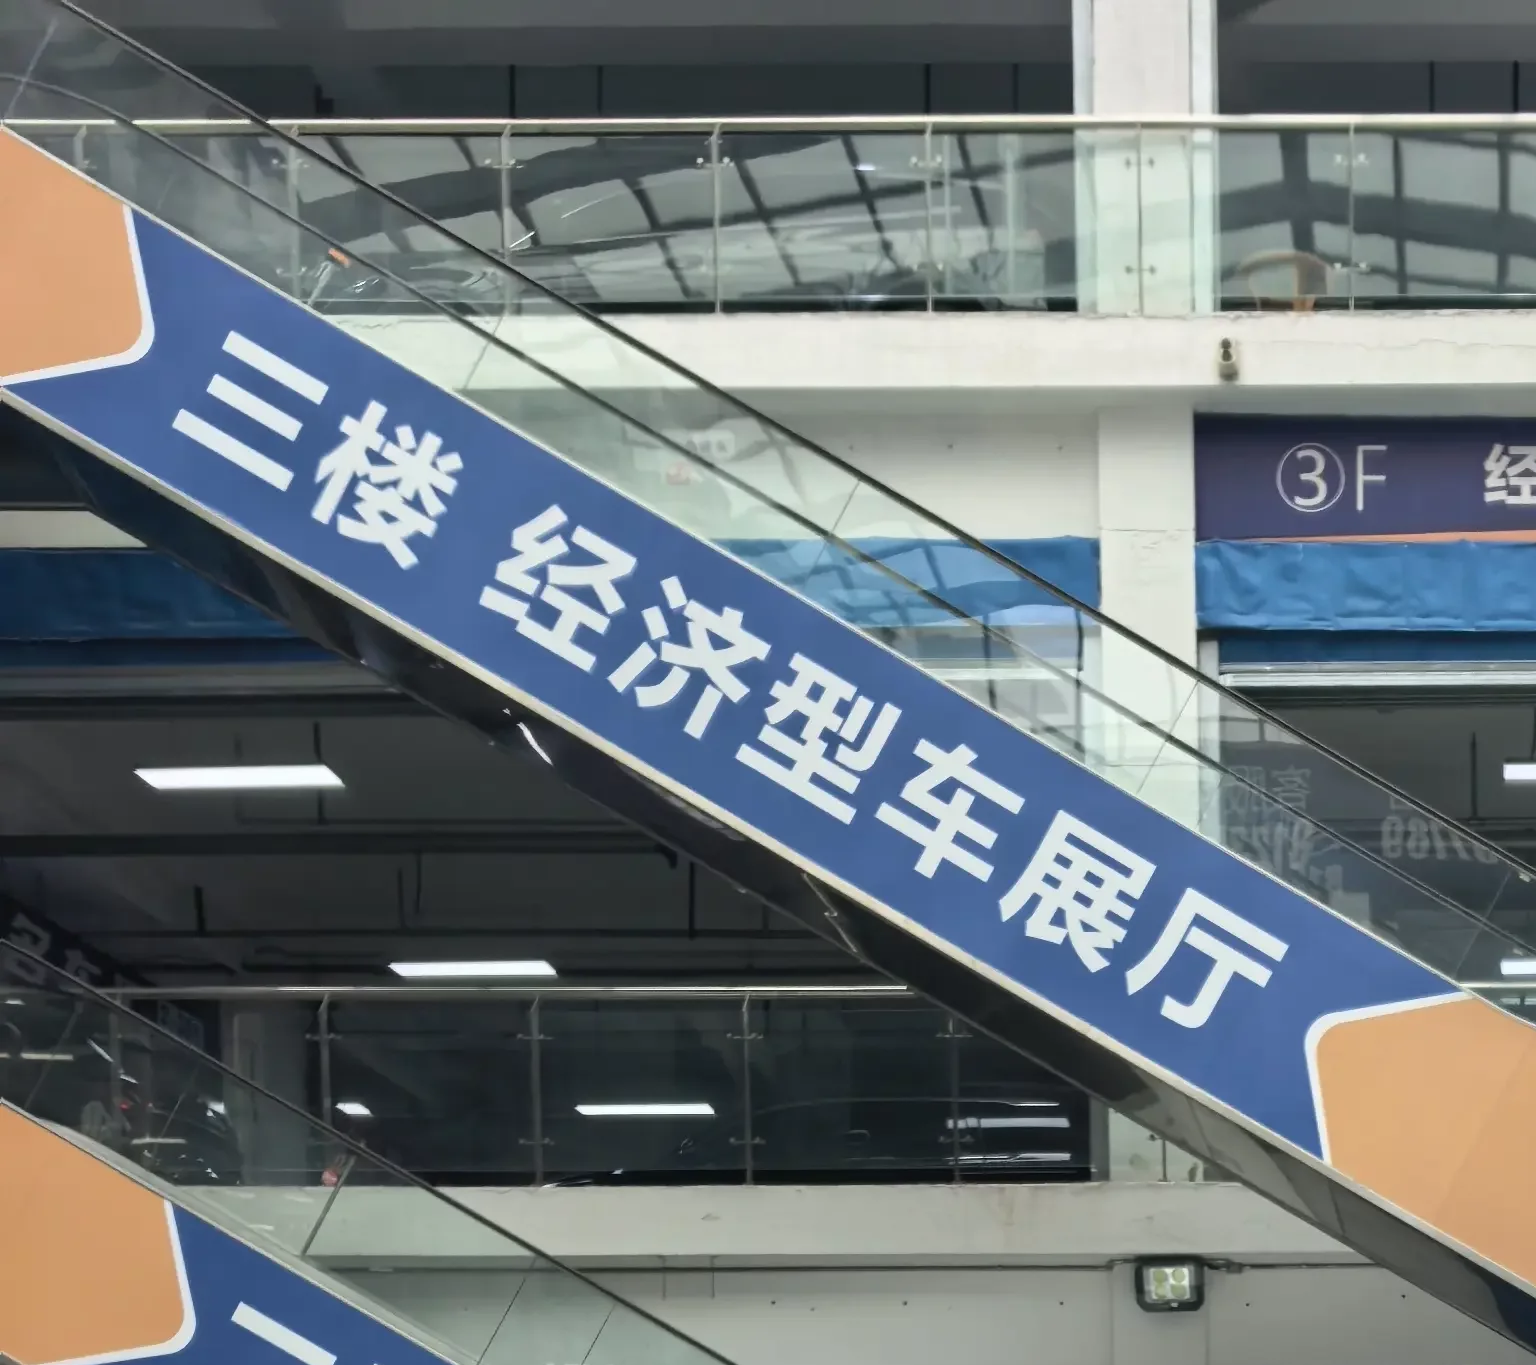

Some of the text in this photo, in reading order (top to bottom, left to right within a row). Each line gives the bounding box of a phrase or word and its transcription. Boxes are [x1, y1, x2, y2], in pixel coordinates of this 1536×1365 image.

[172, 331, 1289, 1028] 三楼 经济型车展厅
